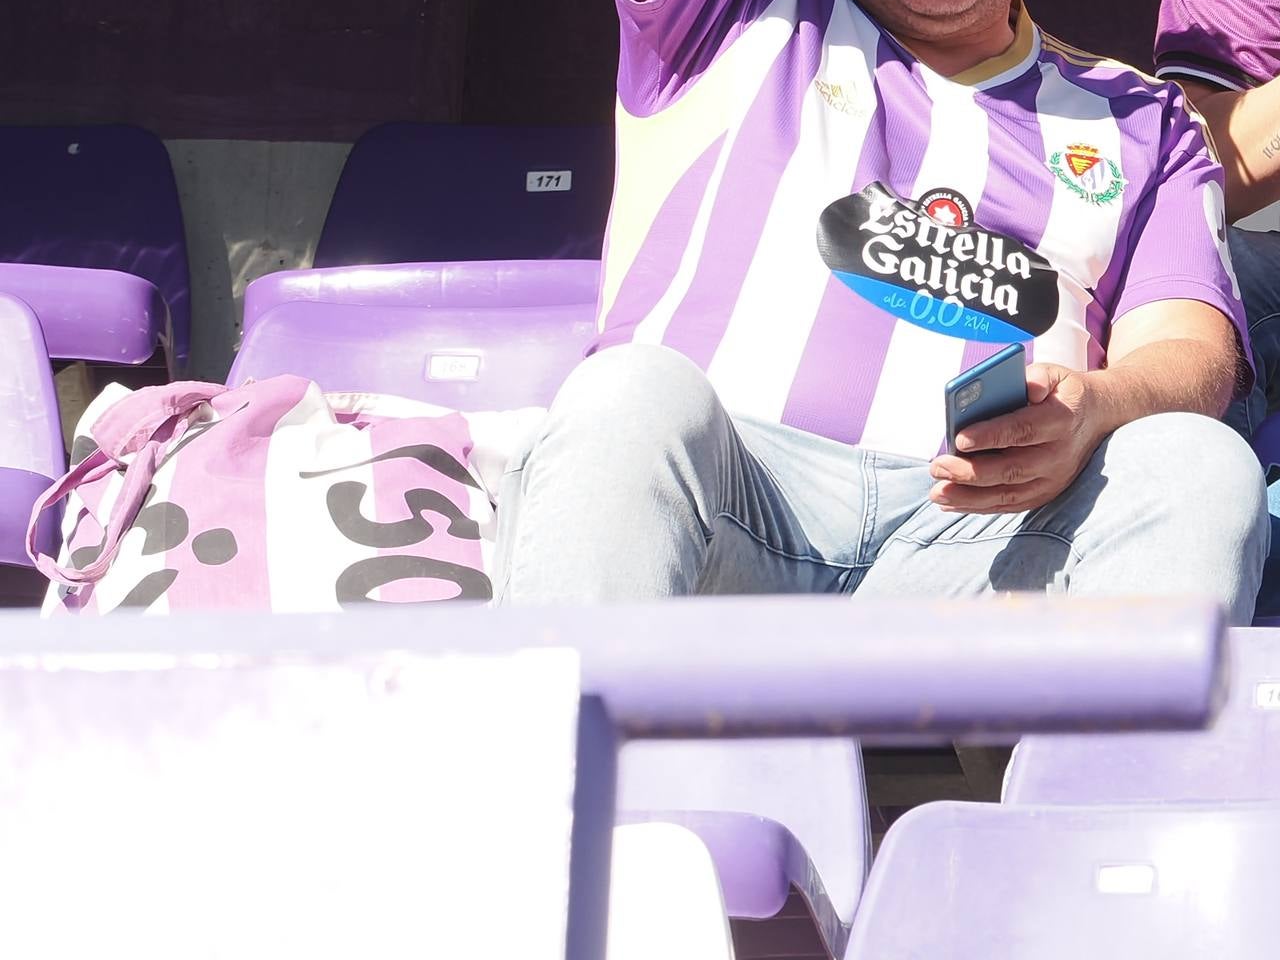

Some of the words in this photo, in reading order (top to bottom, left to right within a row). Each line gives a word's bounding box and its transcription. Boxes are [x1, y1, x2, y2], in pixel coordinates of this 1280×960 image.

[536, 175, 562, 188] 171
[859, 195, 1032, 280] Estrella
[861, 235, 1019, 316] Galicia
[909, 288, 965, 327] 0,0
